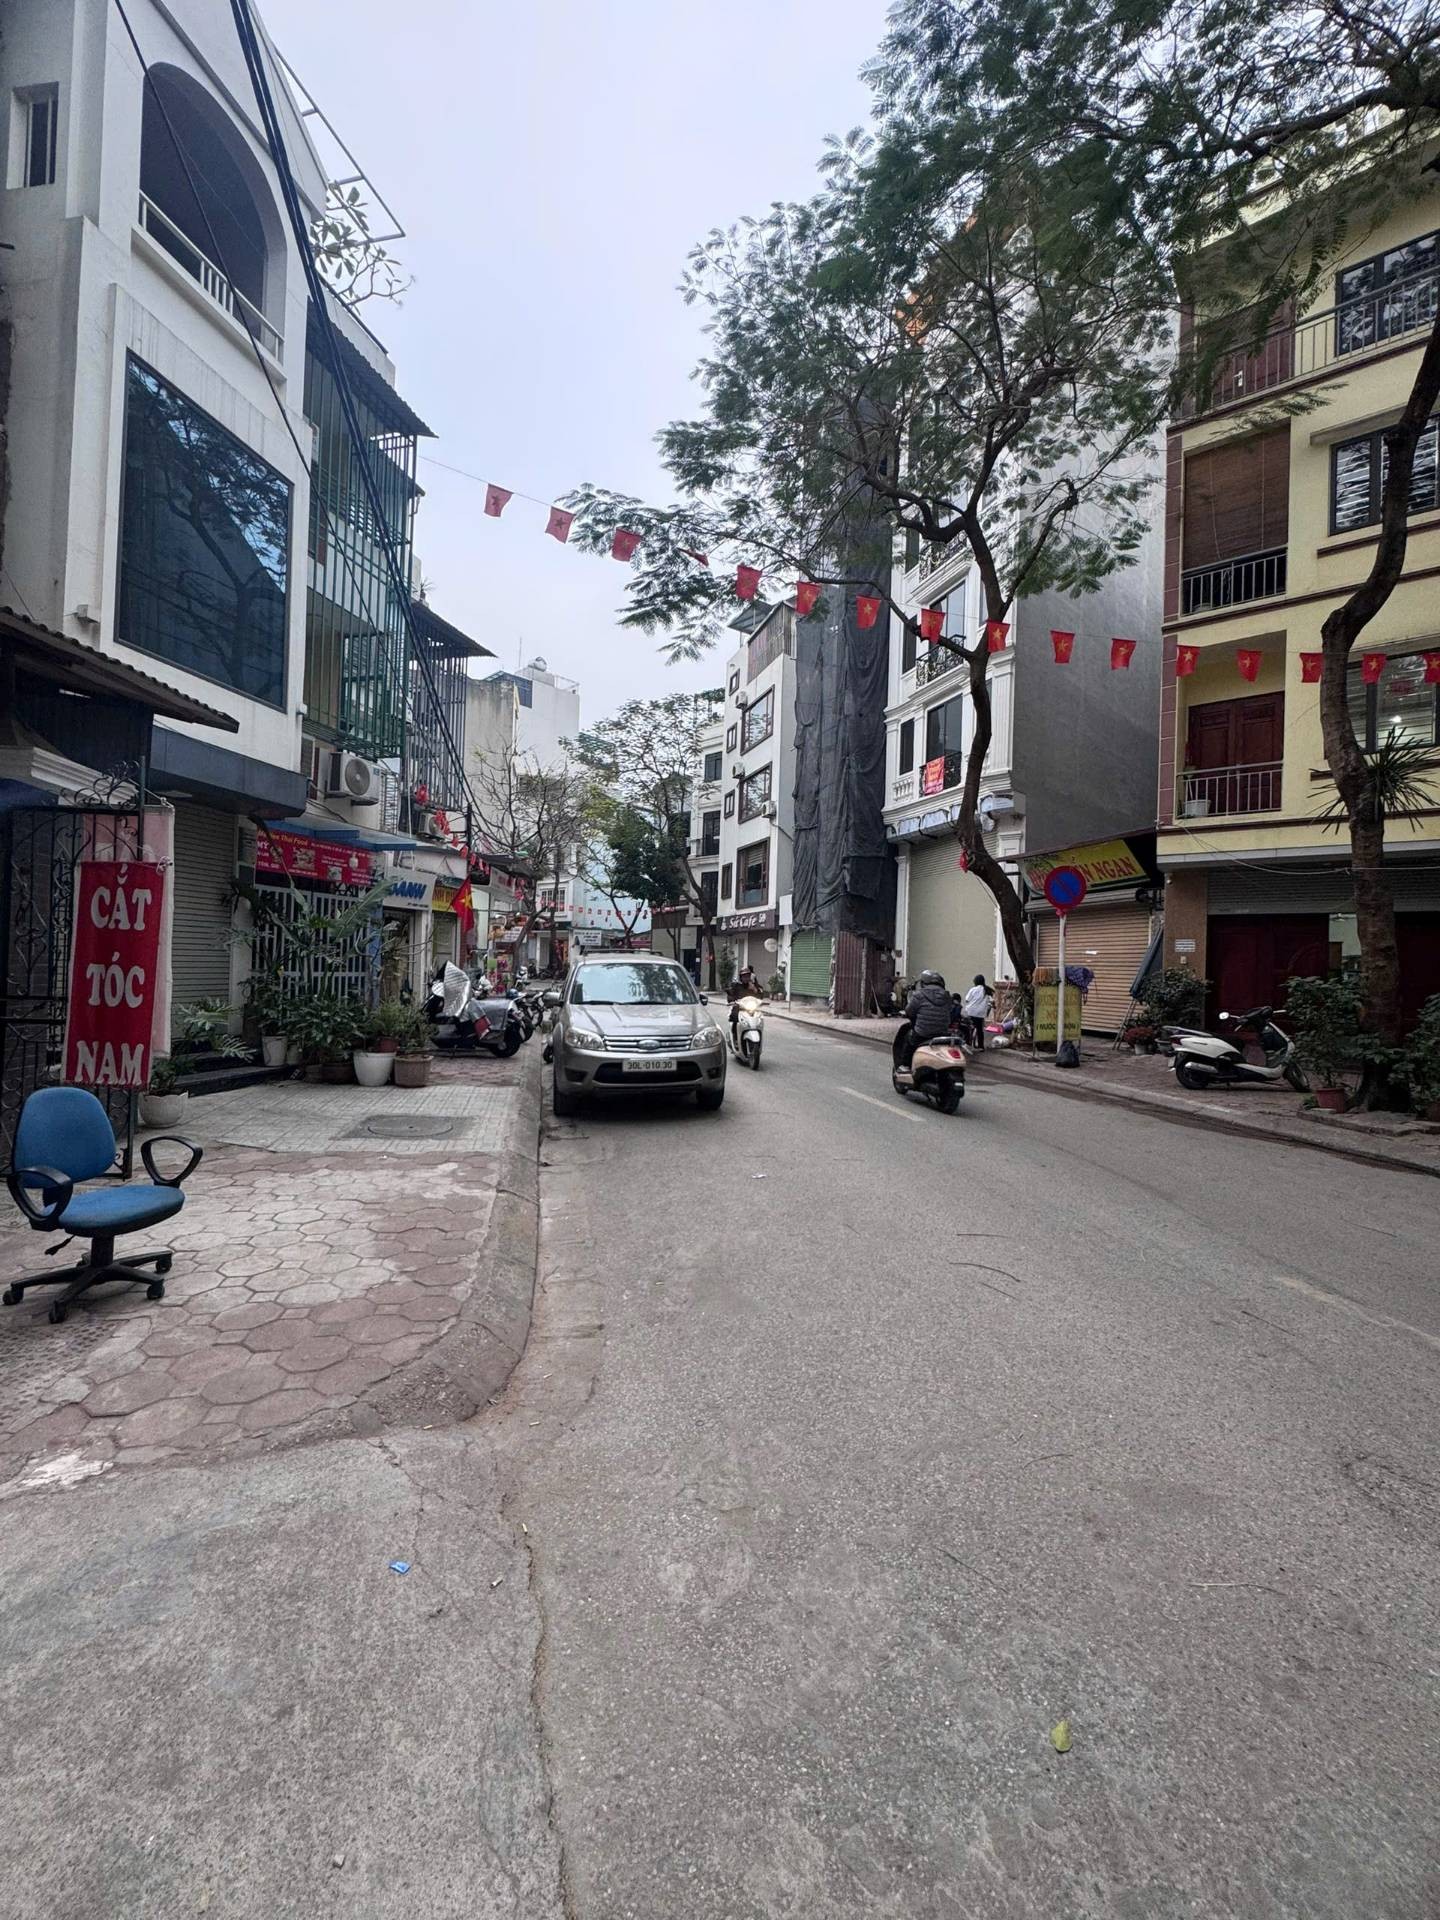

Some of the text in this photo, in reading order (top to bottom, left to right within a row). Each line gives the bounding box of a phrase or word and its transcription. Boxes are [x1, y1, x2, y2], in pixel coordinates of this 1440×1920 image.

[1091, 856, 1136, 881] NGAN
[90, 863, 152, 931] CẮT
[86, 951, 145, 1009] TÓC
[74, 1039, 145, 1086] NAM
